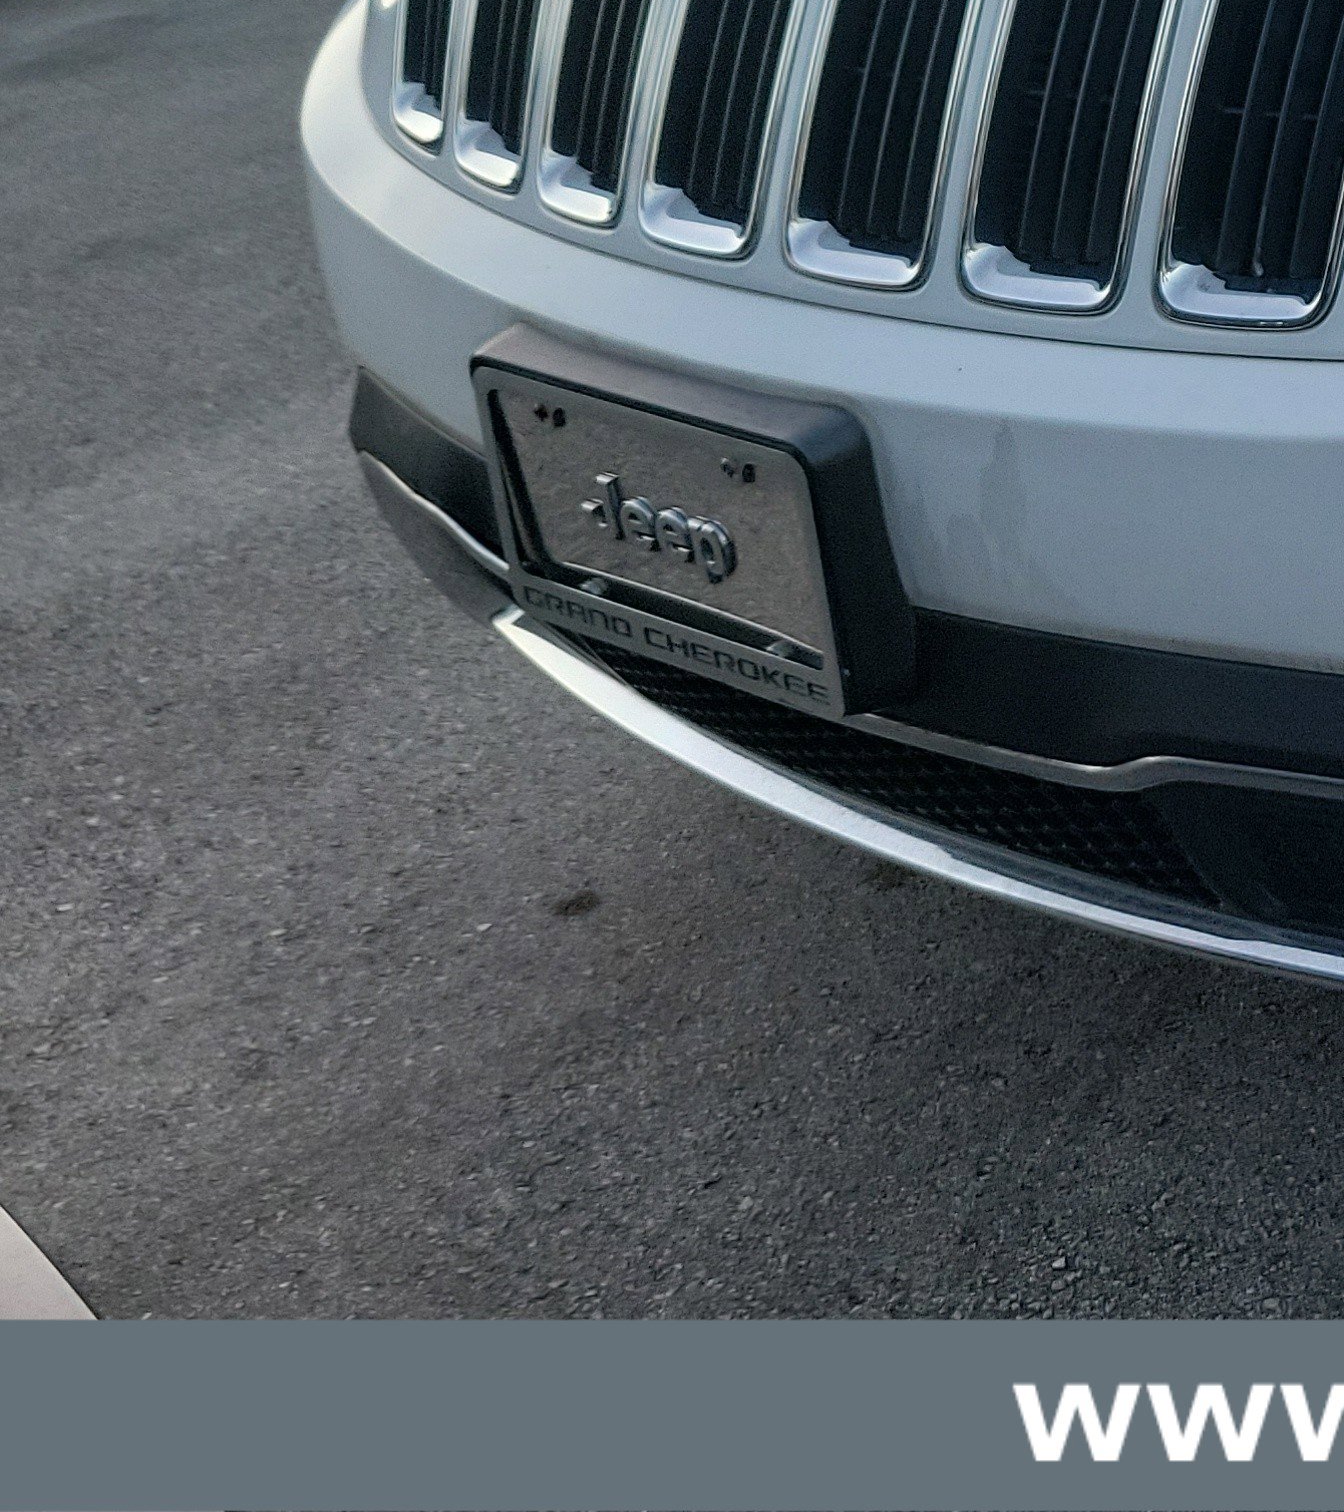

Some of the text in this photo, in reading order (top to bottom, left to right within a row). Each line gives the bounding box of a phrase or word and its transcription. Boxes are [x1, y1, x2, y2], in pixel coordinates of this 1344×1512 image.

[581, 472, 738, 584] Jeep
[525, 586, 831, 700] GRAND CHEROKEE
